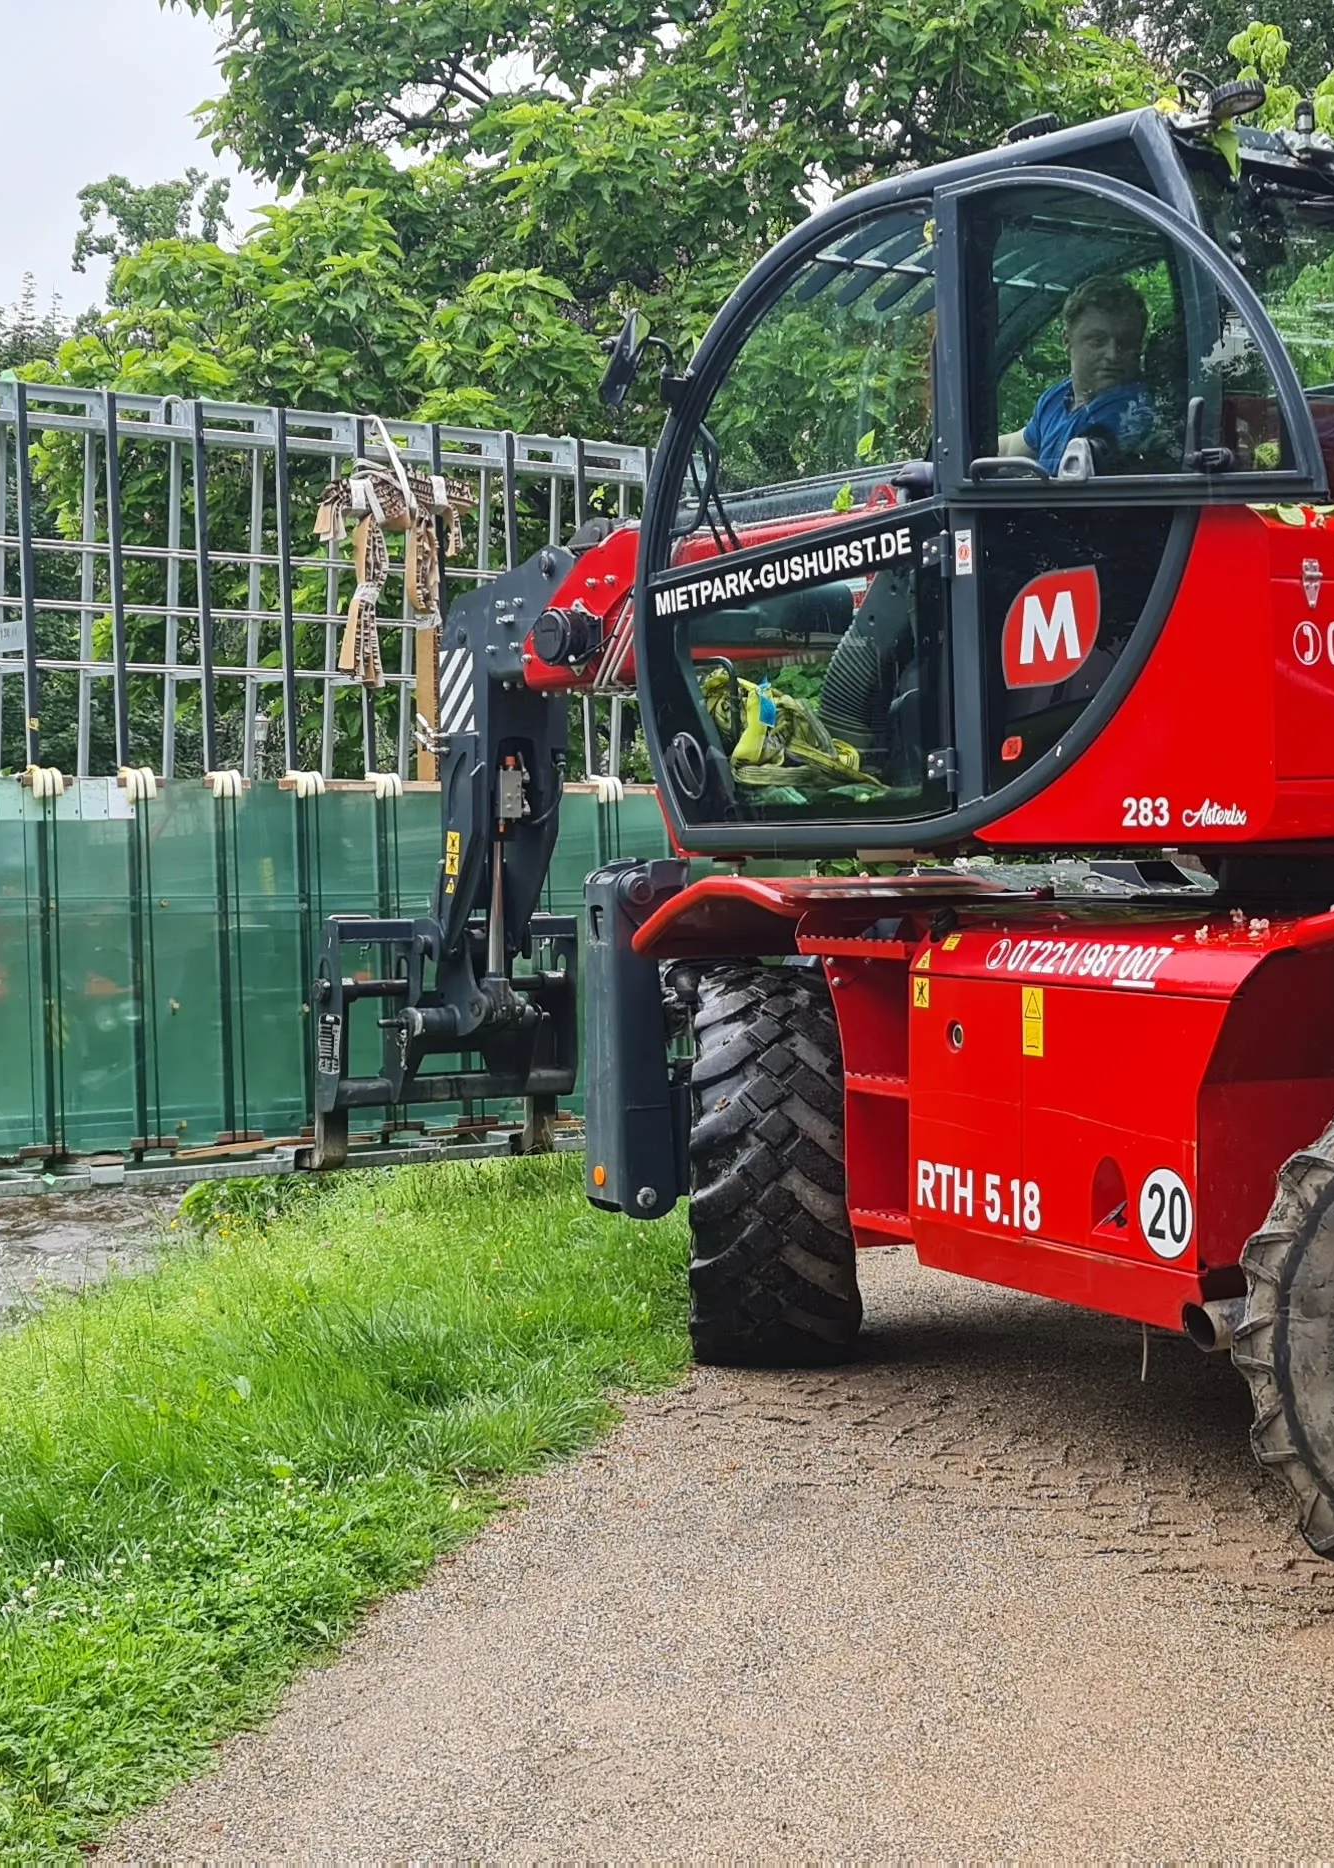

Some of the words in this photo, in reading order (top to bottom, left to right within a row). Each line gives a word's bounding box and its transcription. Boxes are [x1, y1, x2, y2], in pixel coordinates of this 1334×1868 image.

[655, 527, 912, 616] MIETPARK-GUSHURST.DE
[1020, 591, 1081, 664] M
[1122, 797, 1170, 827] 283
[1182, 798, 1247, 827] Asterix
[1007, 939, 1174, 984] 07221/987007
[917, 1159, 973, 1217] RTH
[985, 1173, 1041, 1232] 5.18
[1148, 1183, 1187, 1244] 20
